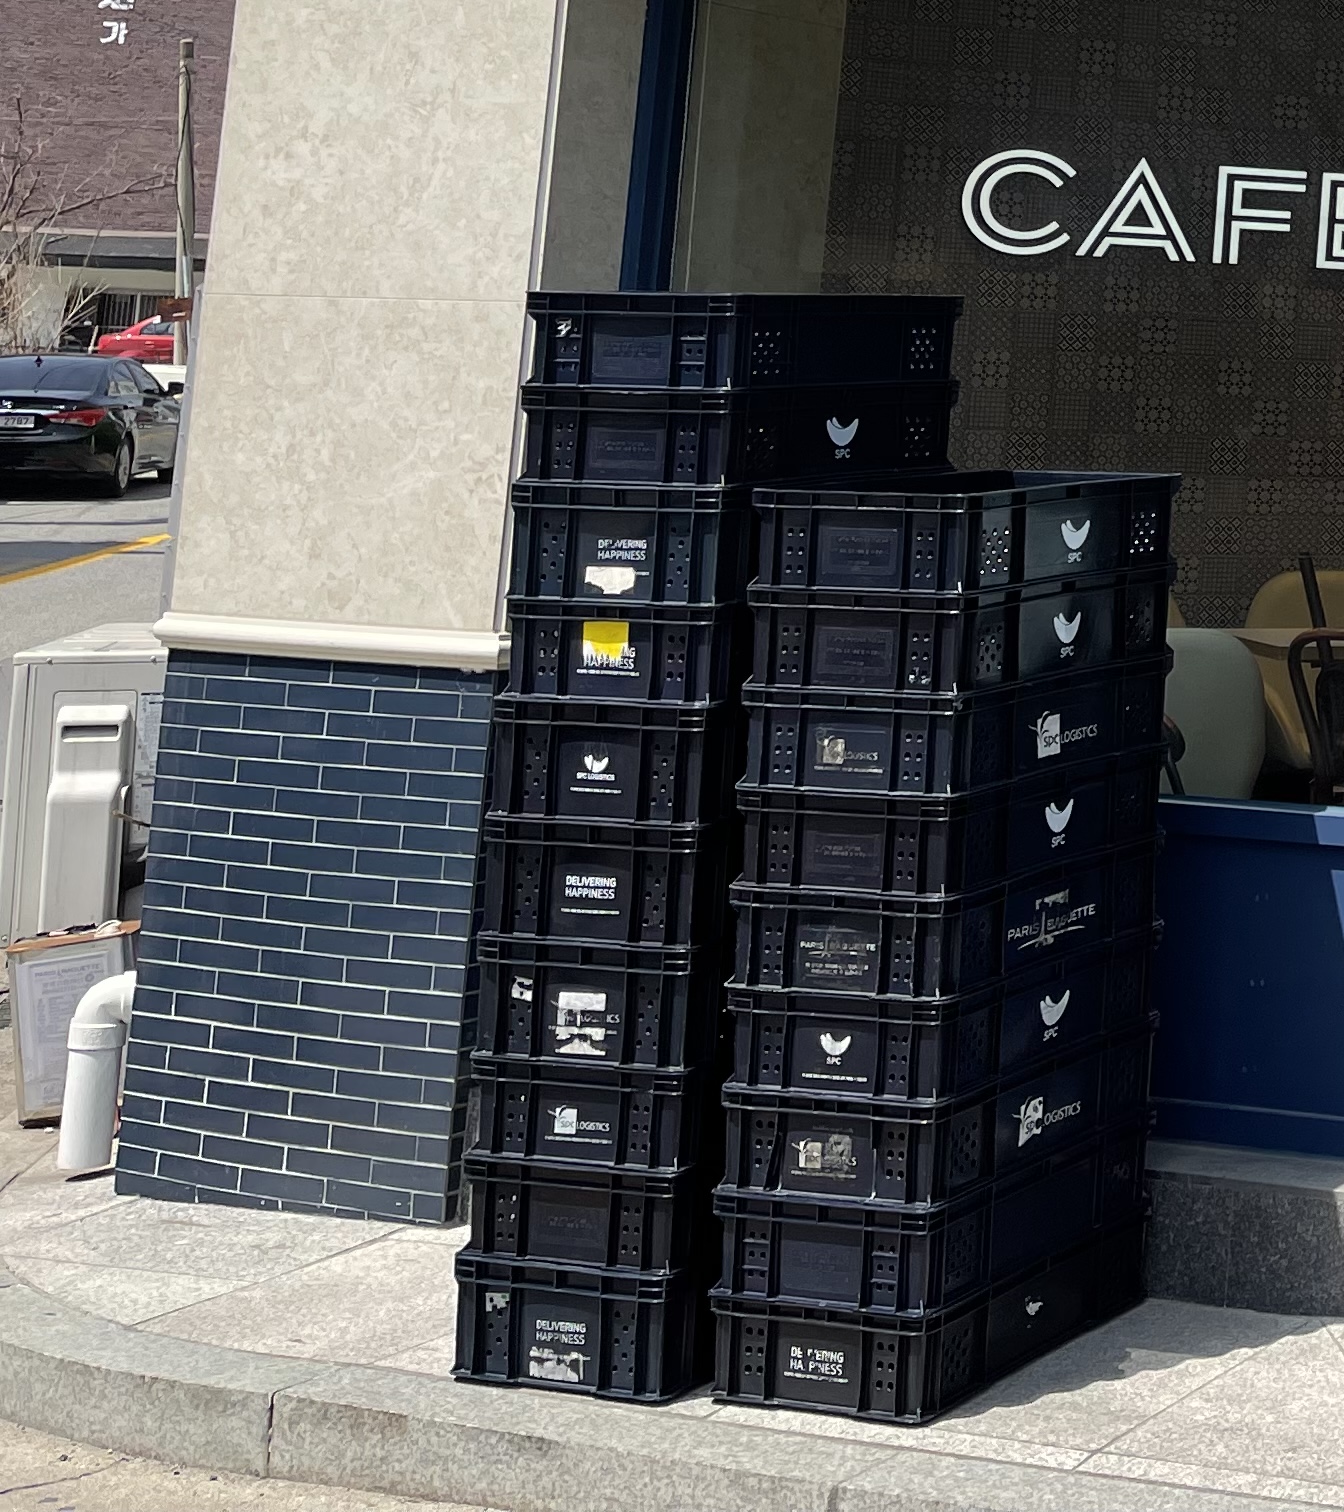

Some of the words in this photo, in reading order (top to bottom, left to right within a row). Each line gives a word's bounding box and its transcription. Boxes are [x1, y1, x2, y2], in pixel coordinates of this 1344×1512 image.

[834, 448, 850, 459] SPC
[597, 549, 647, 561] HAPPINESS
[1067, 551, 1083, 564] SPC
[1060, 645, 1075, 658] SPC
[1060, 723, 1098, 745] LOGISTICS
[1051, 833, 1066, 849] SPC
[565, 874, 617, 888] DELIVERING
[564, 887, 616, 900] HAPPINESS
[1007, 920, 1041, 943] PARIS
[1042, 1026, 1059, 1042] SPC
[826, 1055, 842, 1066] SPC
[577, 1120, 611, 1133] LOGISTICS
[535, 1318, 587, 1334] DELIVERING
[535, 1330, 586, 1346] HAPPINESS
